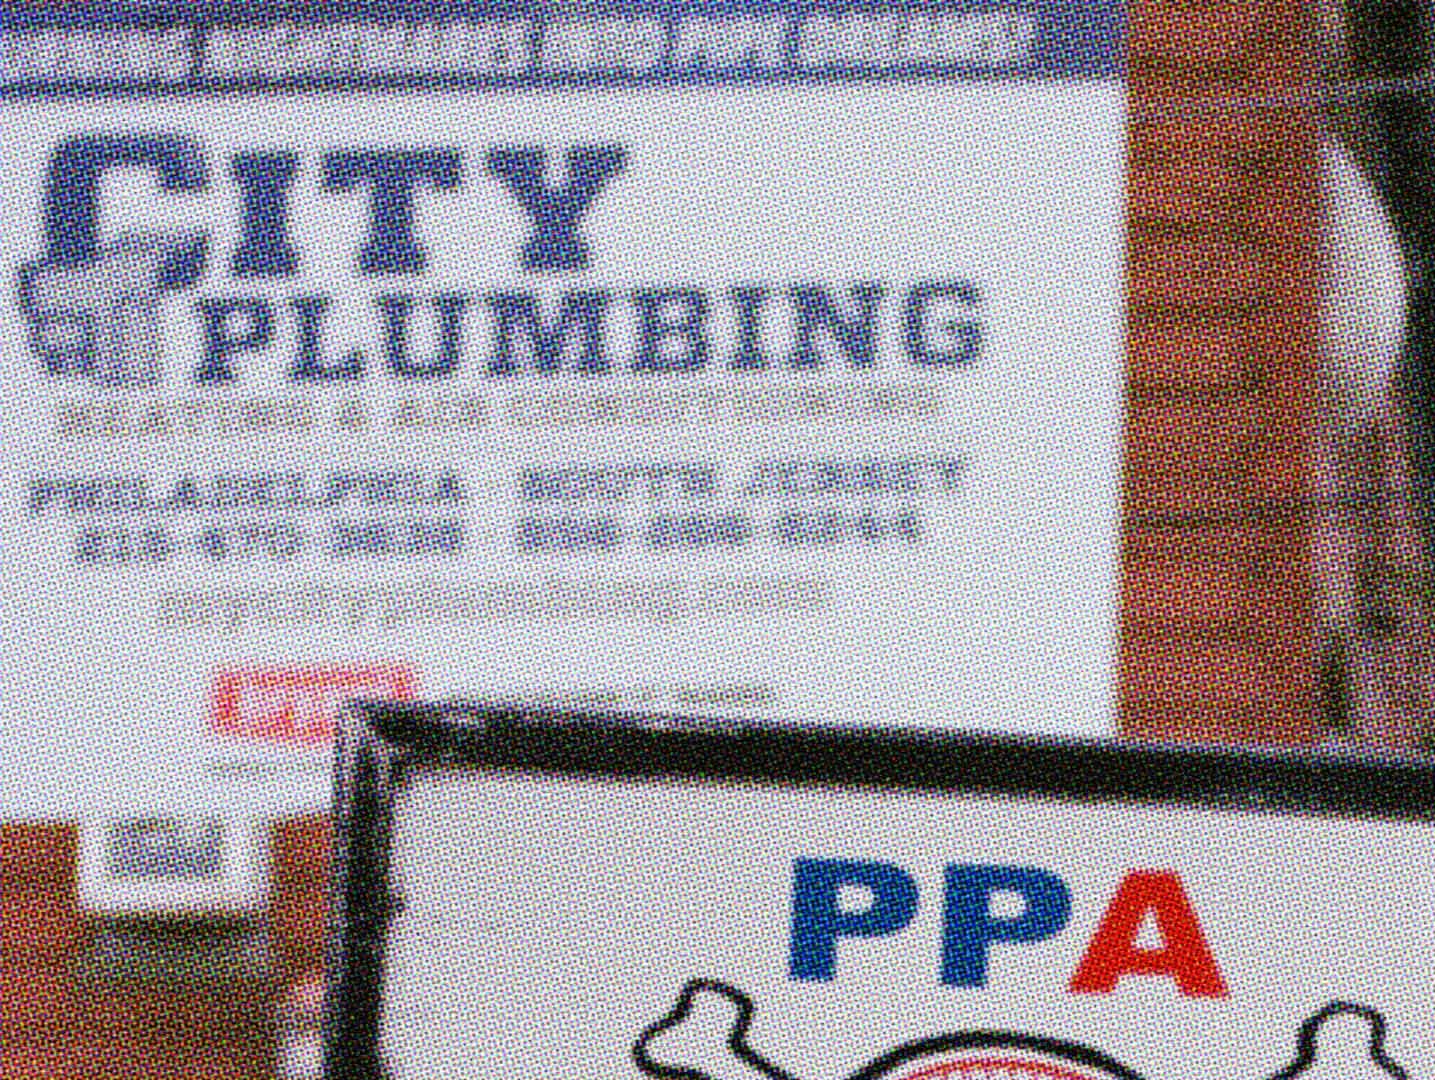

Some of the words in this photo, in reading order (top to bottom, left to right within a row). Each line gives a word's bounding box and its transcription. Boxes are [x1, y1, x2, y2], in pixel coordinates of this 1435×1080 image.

[672, 13, 787, 68] PIPE
[42, 132, 628, 290] CITY
[196, 278, 986, 384] PLUMBING
[56, 396, 314, 438] HEATING
[393, 391, 488, 429] AIR
[504, 382, 944, 427] CONDITIONING
[27, 469, 466, 515] PHILADELPHIA
[518, 462, 716, 504] SOUTH
[738, 453, 969, 497] JERSEY
[788, 857, 1230, 999] PPA
